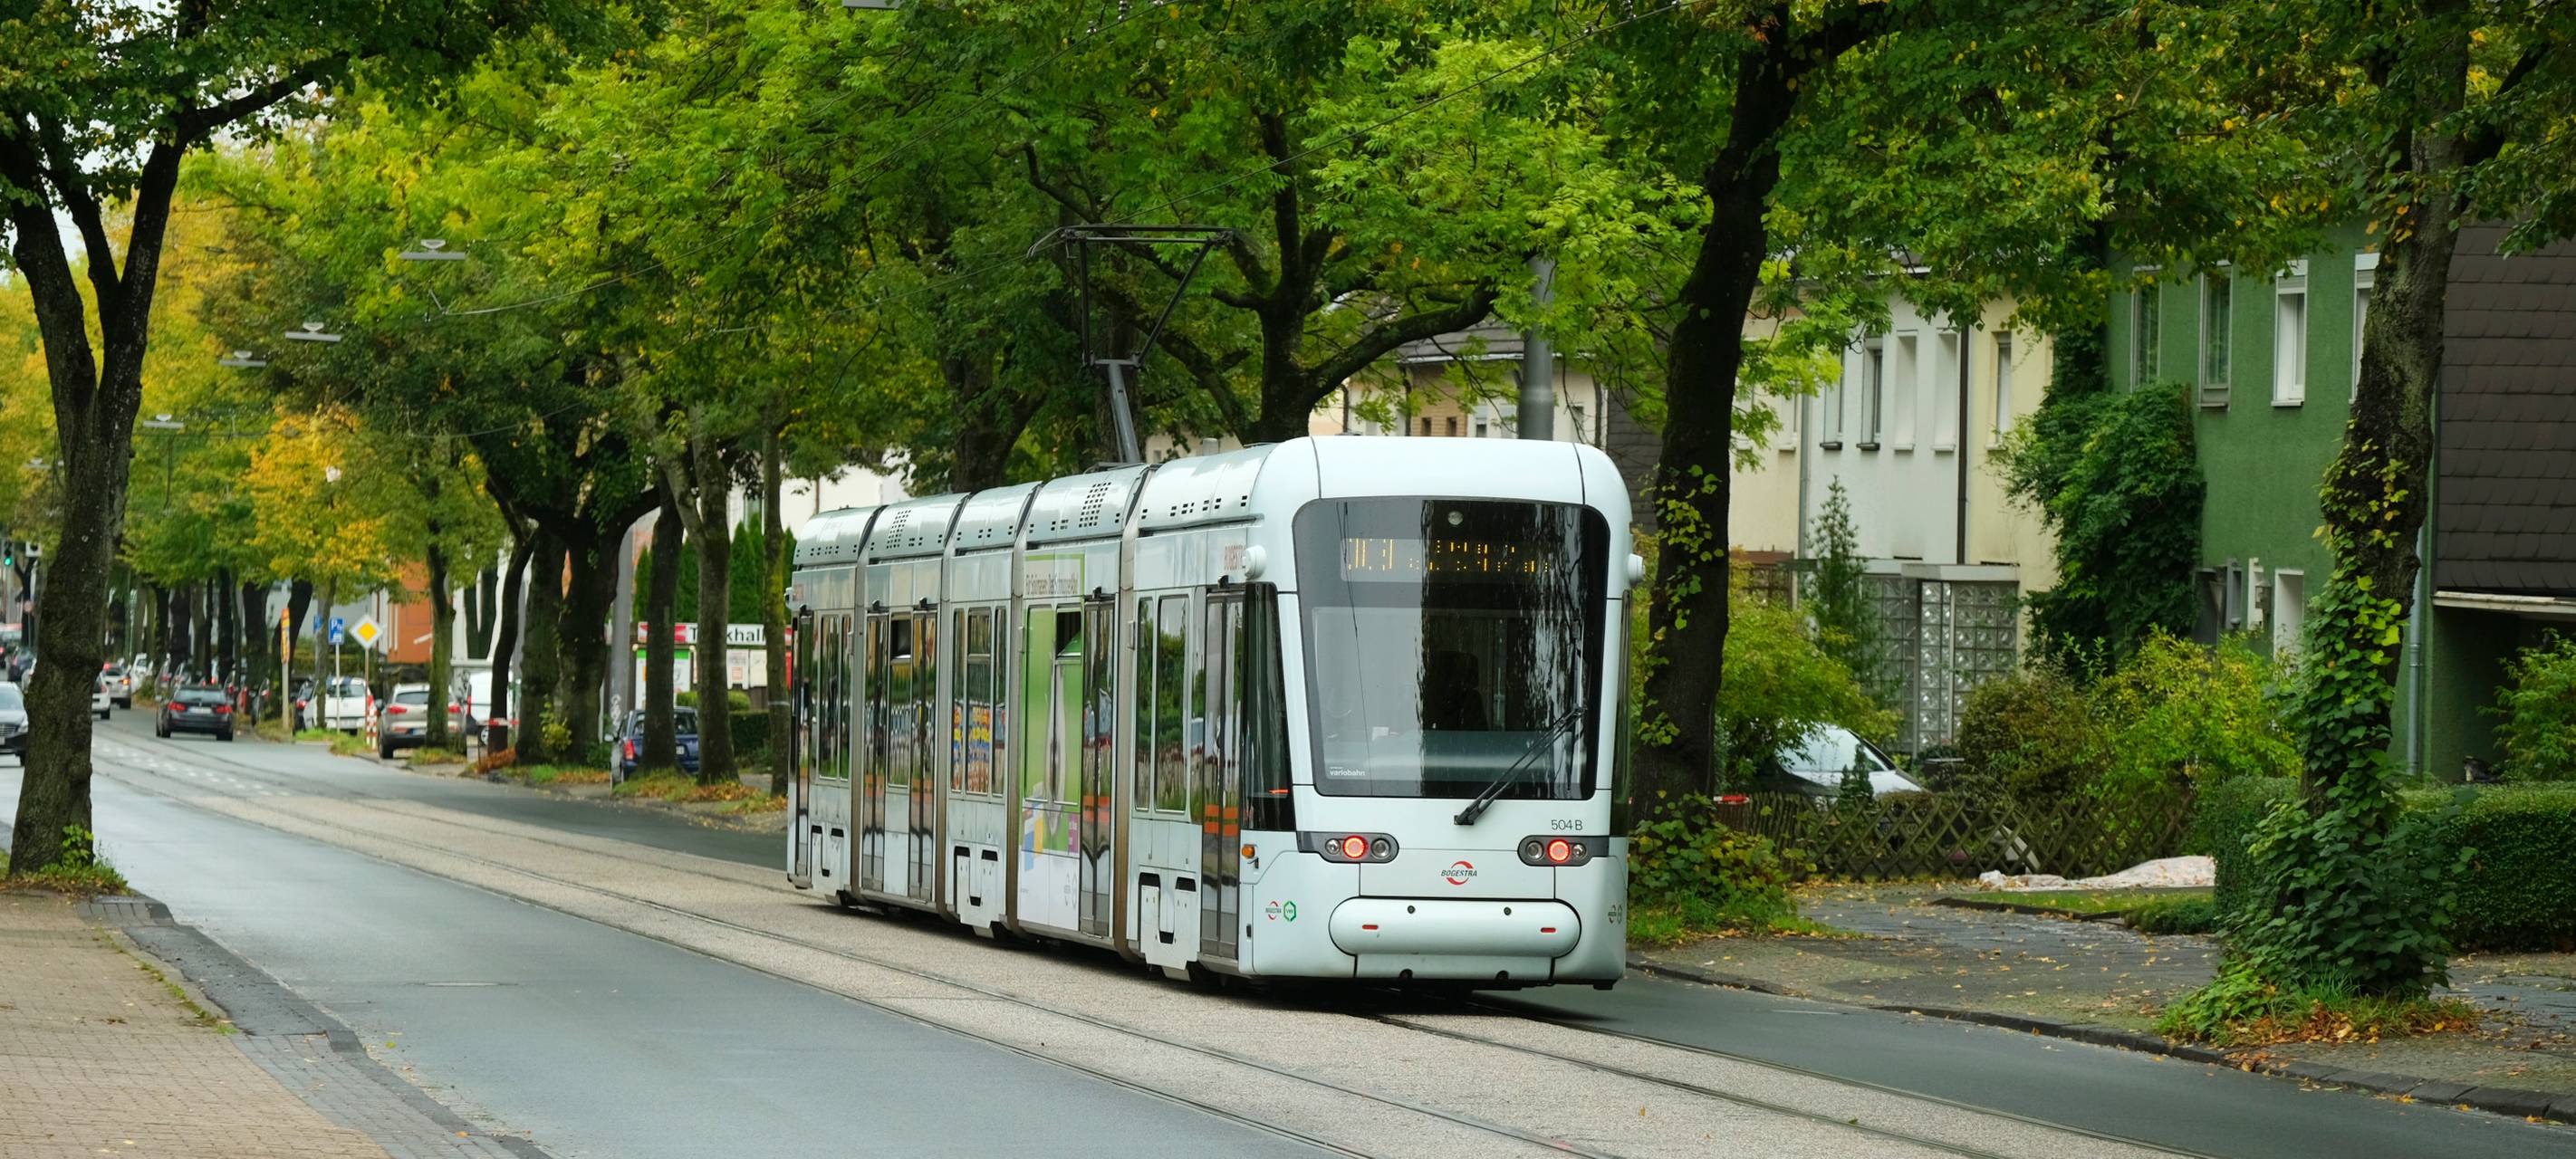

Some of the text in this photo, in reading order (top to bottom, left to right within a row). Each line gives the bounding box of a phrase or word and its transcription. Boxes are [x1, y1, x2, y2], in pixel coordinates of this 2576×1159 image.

[689, 627, 765, 642] Tkhall
[1551, 819, 1583, 831] 504 B
